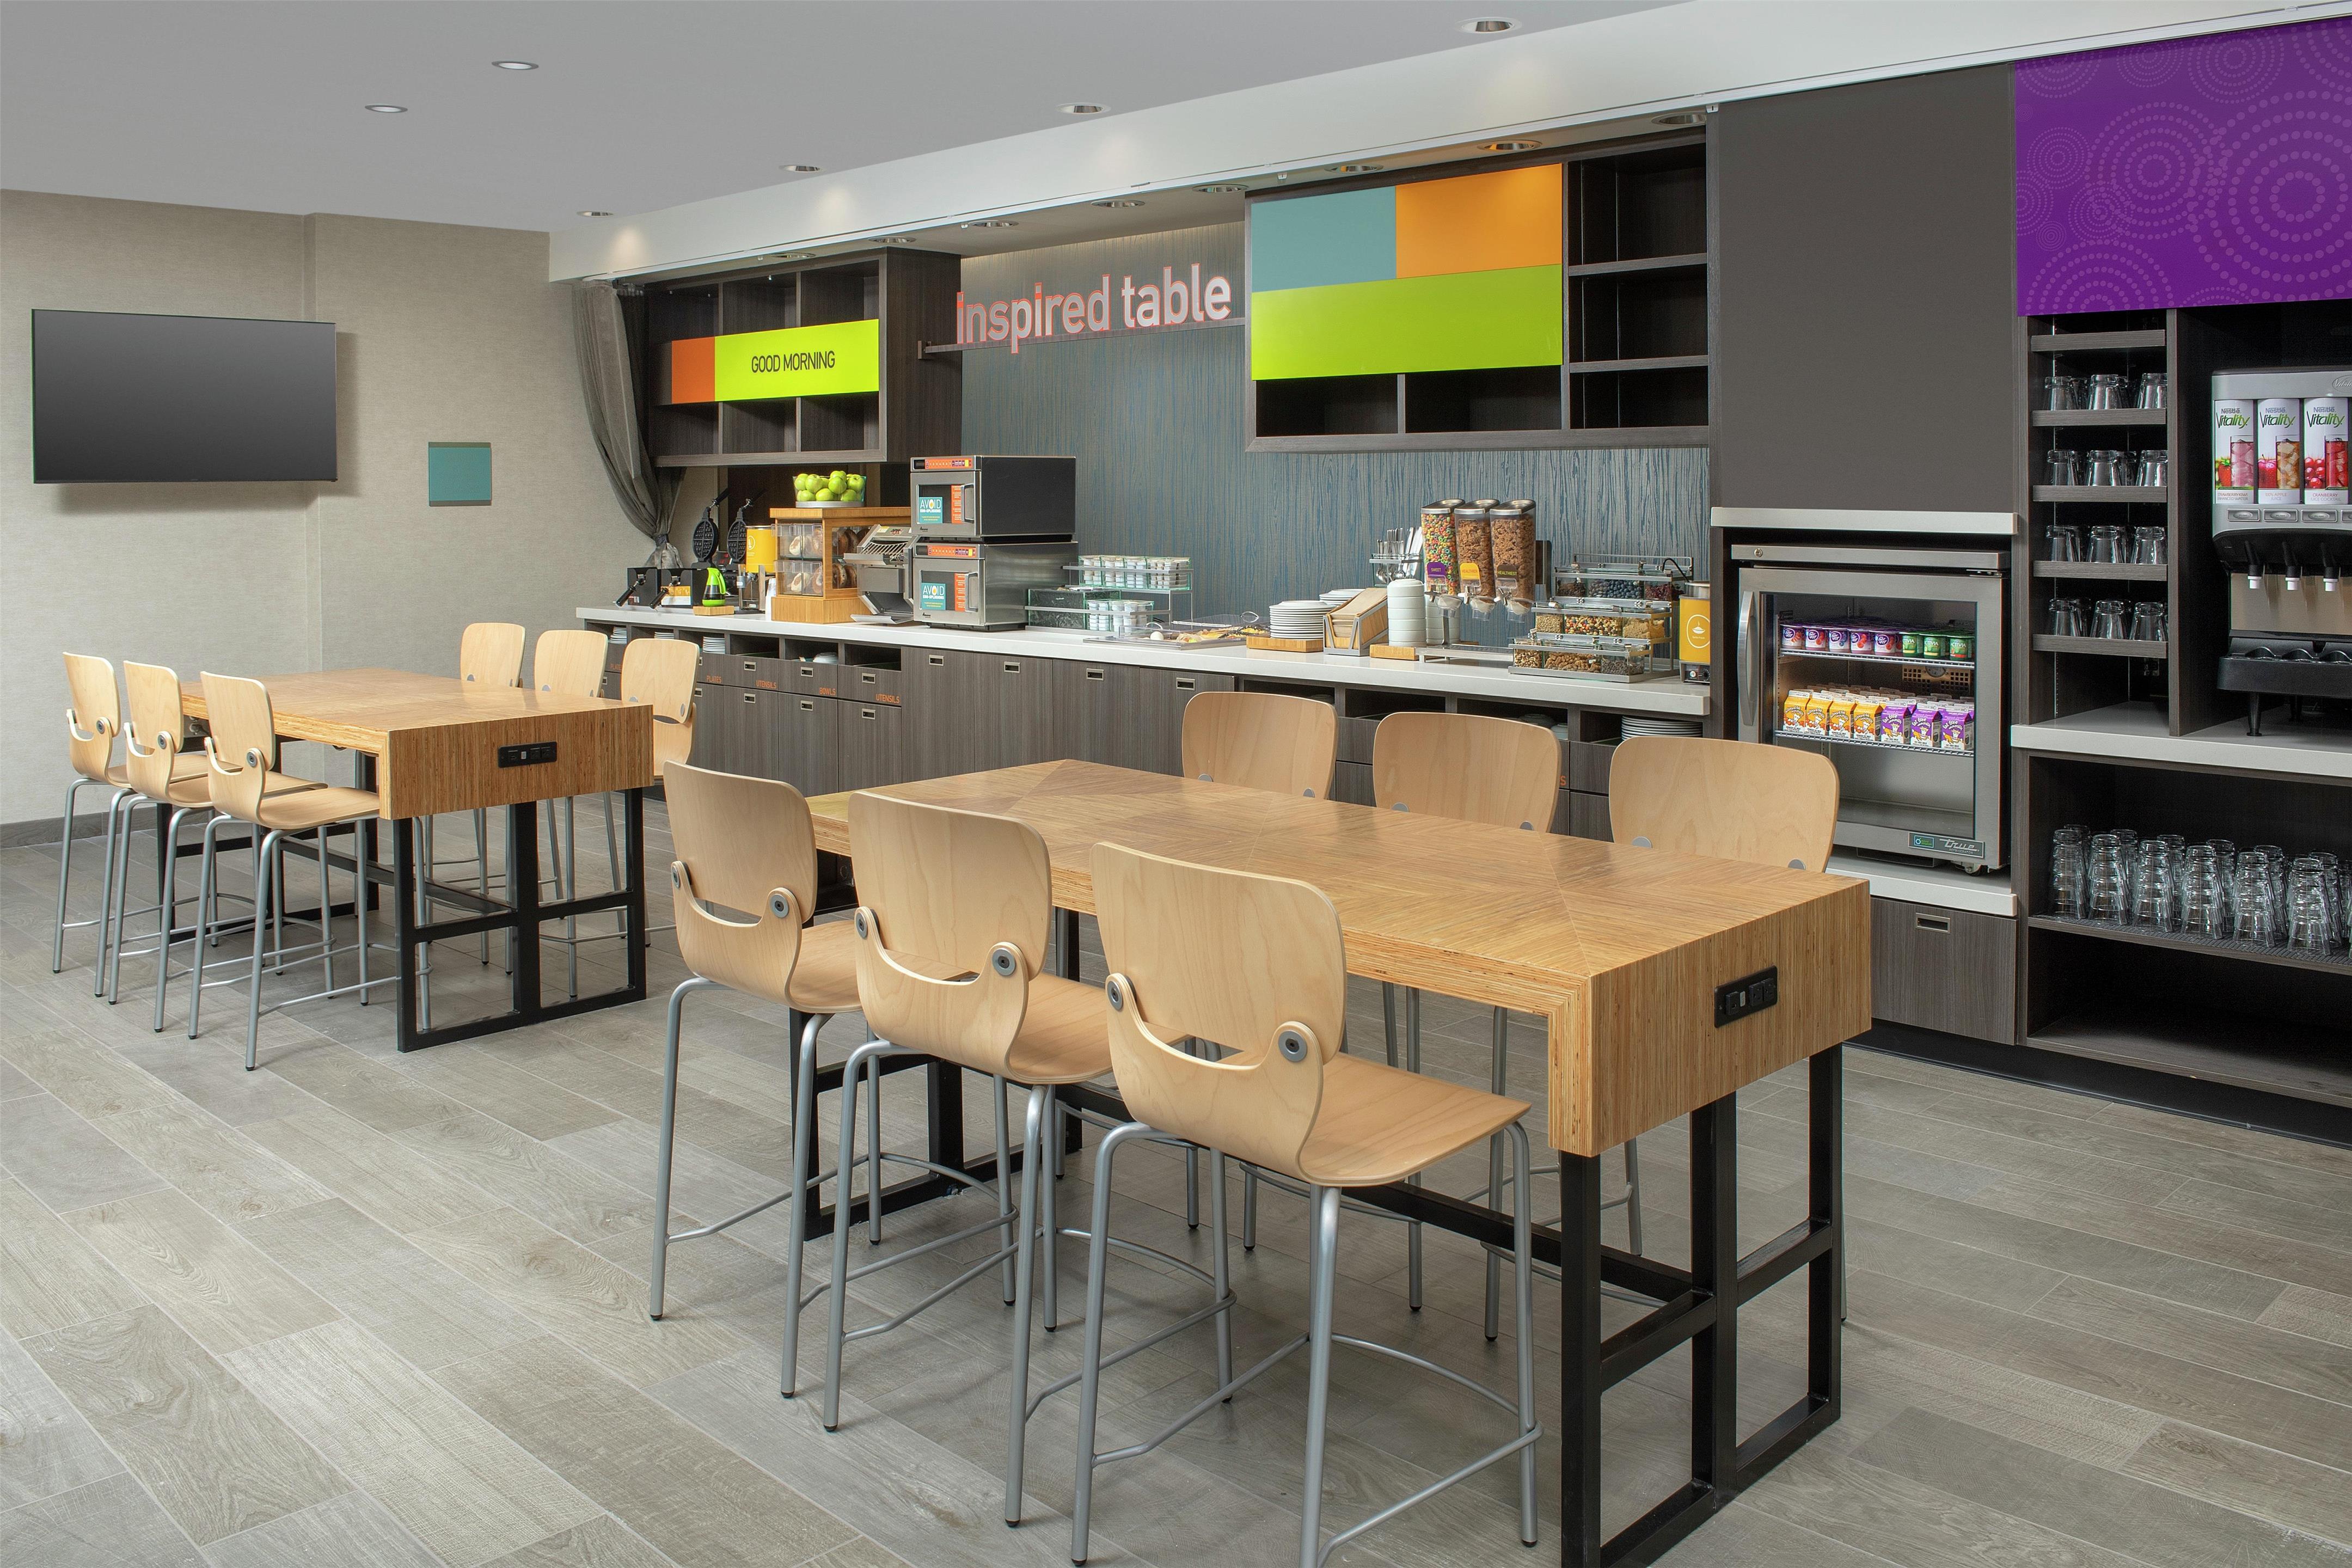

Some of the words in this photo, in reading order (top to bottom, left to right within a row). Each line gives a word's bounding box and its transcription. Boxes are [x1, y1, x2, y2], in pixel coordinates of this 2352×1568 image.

[957, 273, 1111, 354] inspired
[1121, 262, 1232, 328] table
[751, 354, 781, 373] GOOD
[783, 350, 835, 371] MORNING
[2216, 412, 2250, 429] Vitality
[2259, 411, 2296, 429] Vitality
[2306, 411, 2345, 428] Vitality
[920, 499, 941, 510] AVOID
[922, 585, 945, 596] AVOID
[706, 675, 722, 683] PLATES
[756, 679, 777, 689] UTENSILS
[819, 687, 837, 696] BOWLS
[875, 693, 901, 703] UTENSILS
